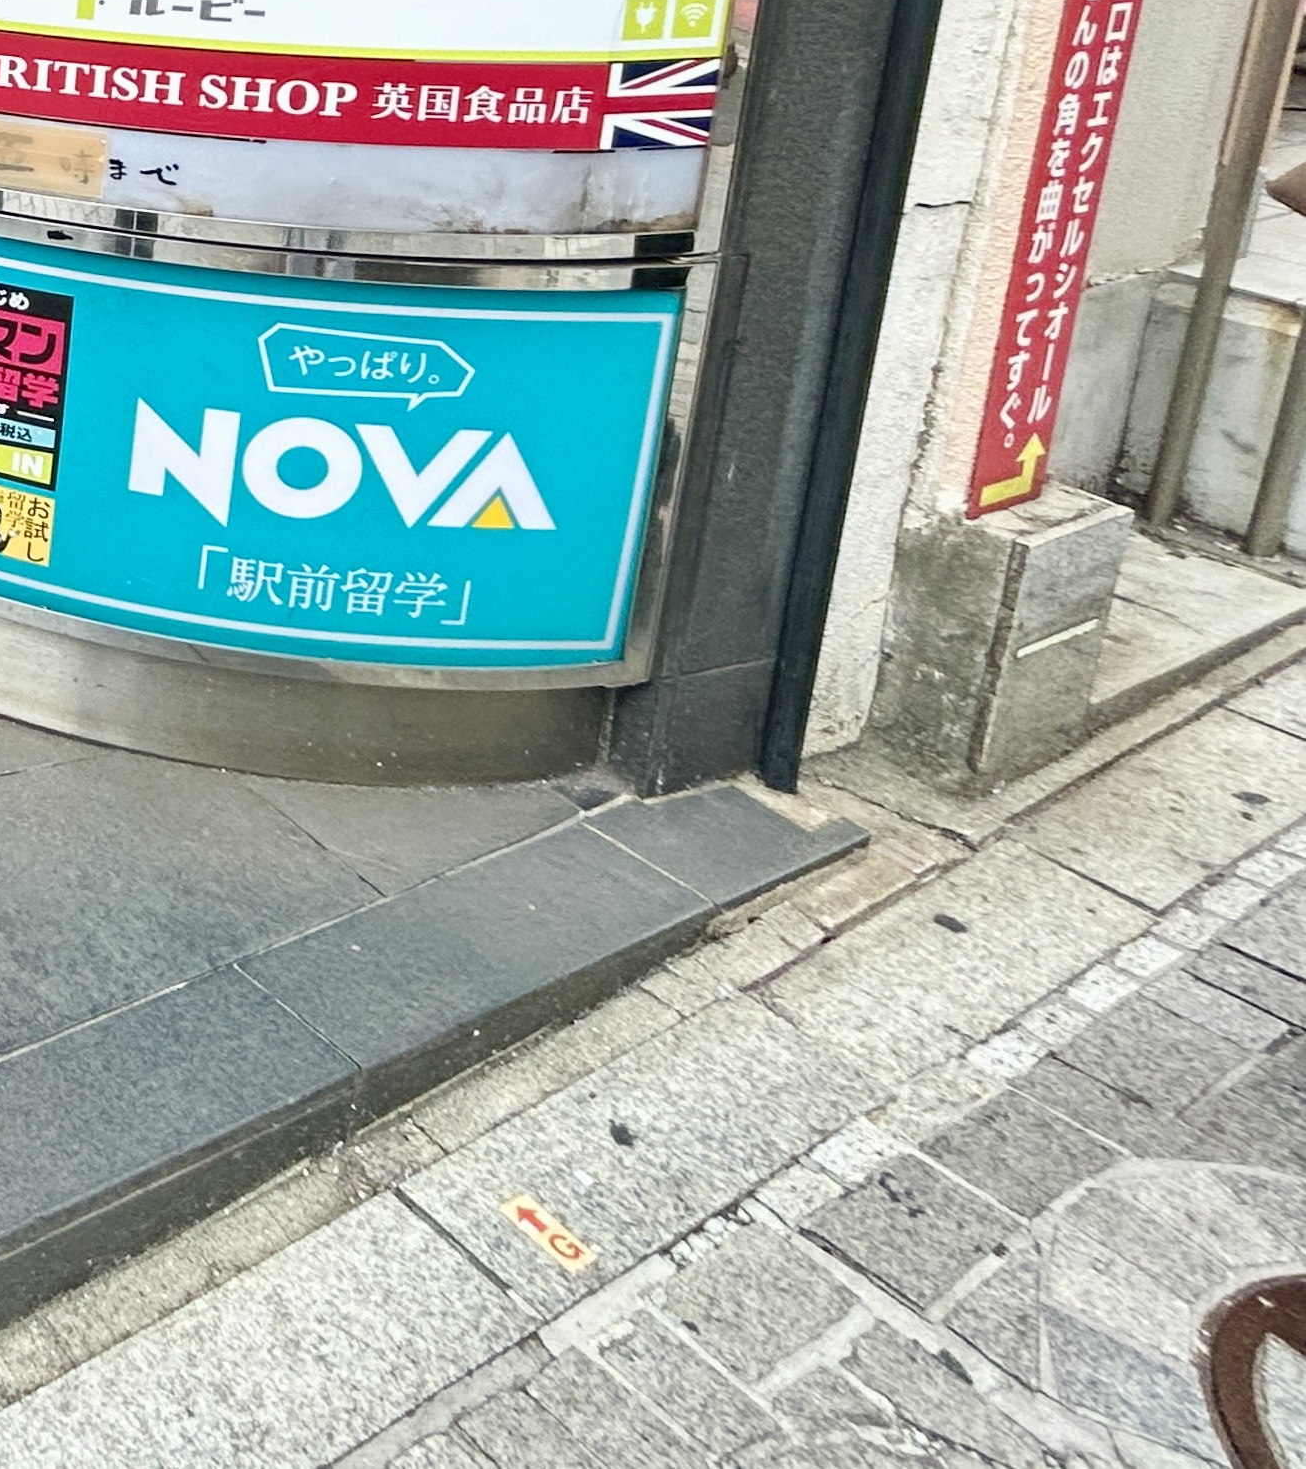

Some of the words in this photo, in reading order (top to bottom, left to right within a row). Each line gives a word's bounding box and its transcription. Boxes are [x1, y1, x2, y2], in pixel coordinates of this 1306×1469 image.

[198, 74, 359, 117] SHOP
[370, 81, 596, 126] 英国食品店
[10, 450, 46, 479] IN
[127, 396, 558, 530] NOVA
[23, 496, 51, 564] お試し
[198, 544, 472, 626] 「駅前留学」
